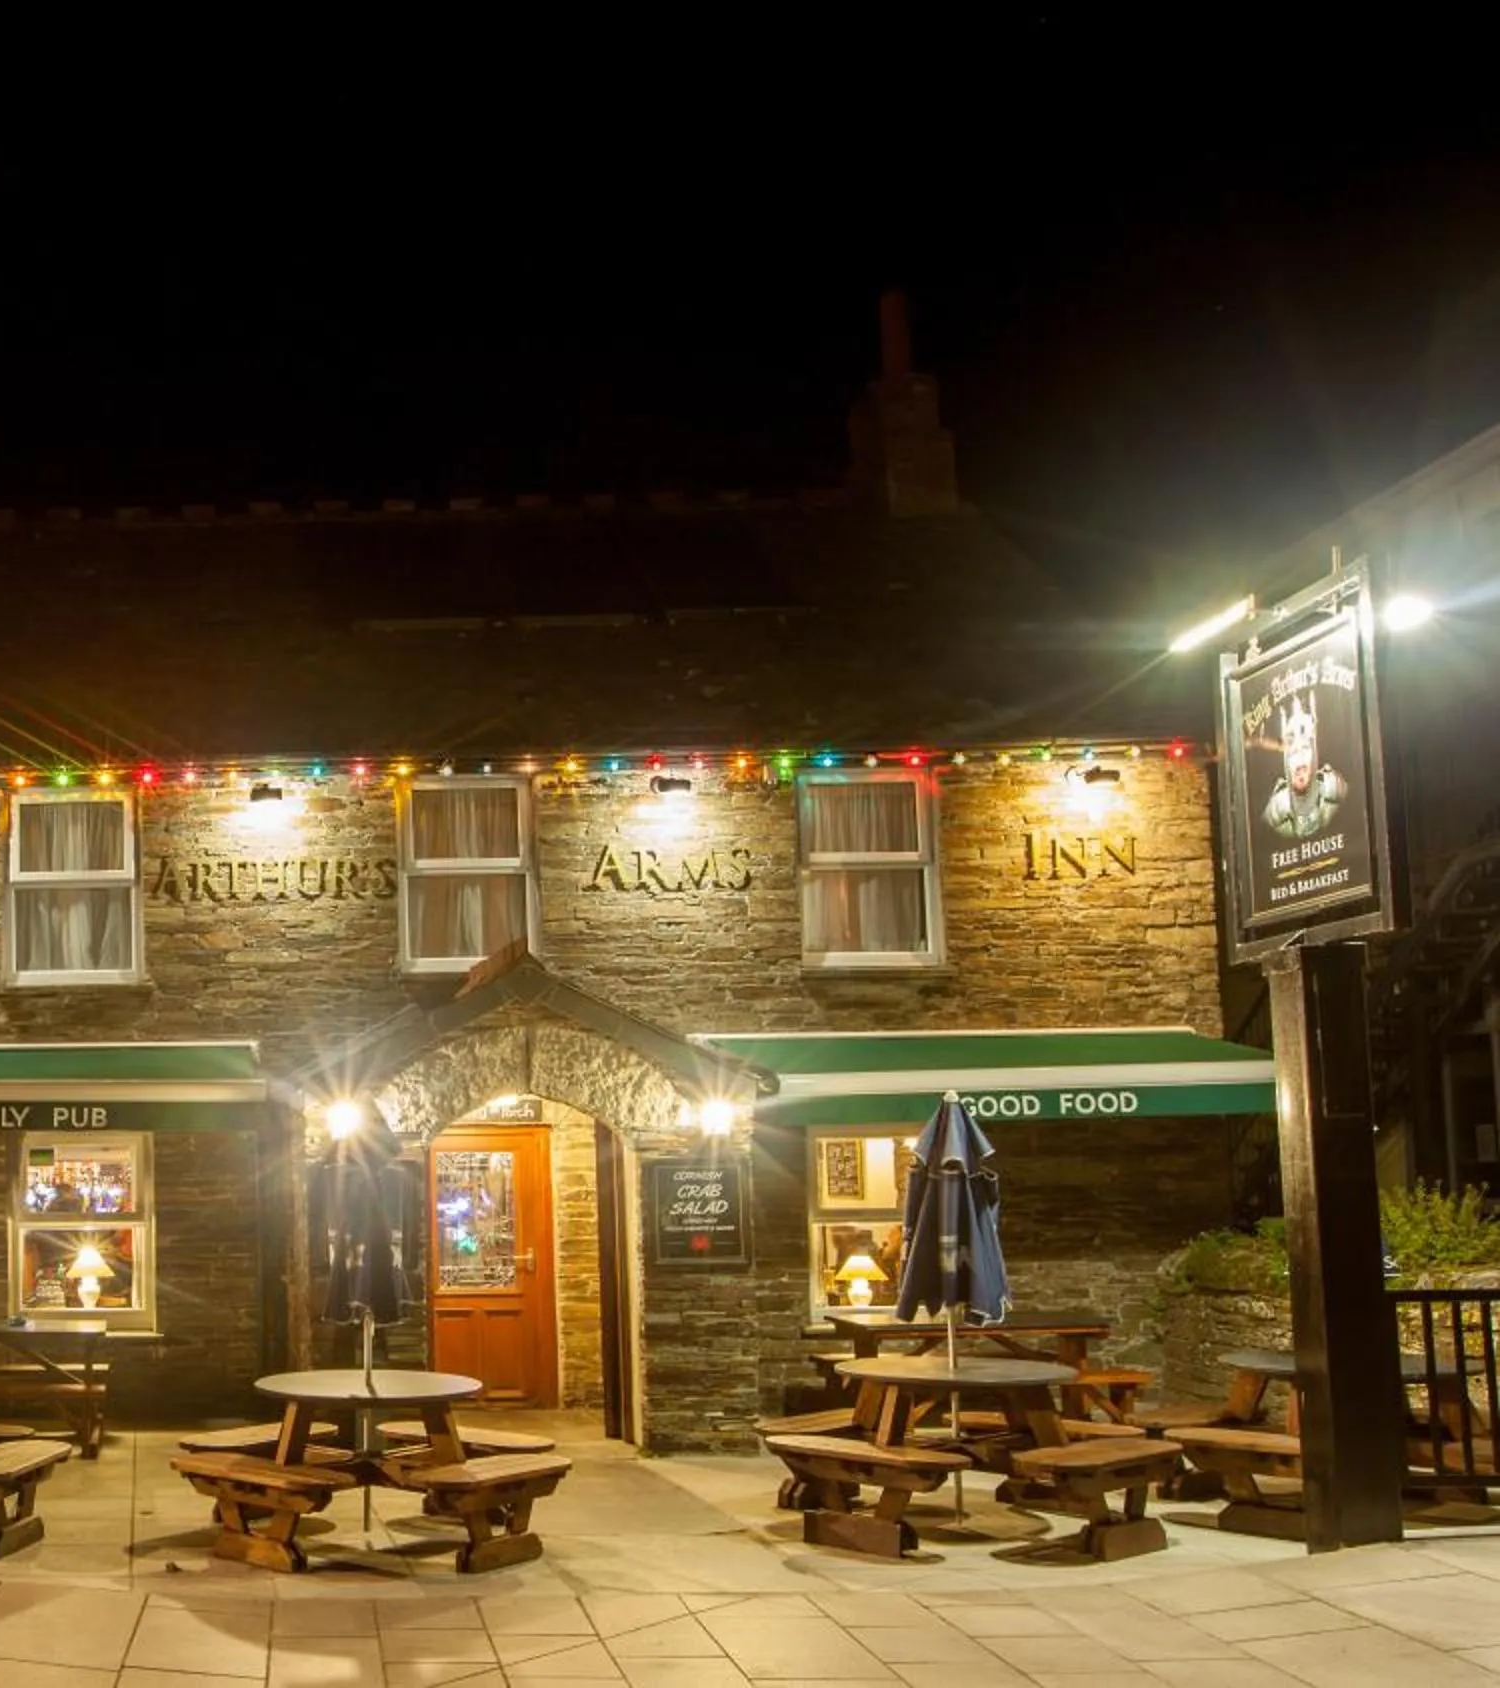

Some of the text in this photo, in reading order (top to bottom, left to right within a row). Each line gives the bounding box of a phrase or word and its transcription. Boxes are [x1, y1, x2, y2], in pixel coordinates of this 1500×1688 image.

[583, 843, 752, 893] ARMS
[1021, 830, 1138, 881] INN
[1272, 833, 1345, 869] FREE HOUSE
[1270, 885, 1289, 901] BED
[1297, 867, 1350, 894] BREAKFAST
[52, 1106, 109, 1128] PUB
[959, 1091, 1139, 1118] GOOD FOOD
[676, 1183, 724, 1199] CRAB
[668, 1199, 729, 1216] SALAD
